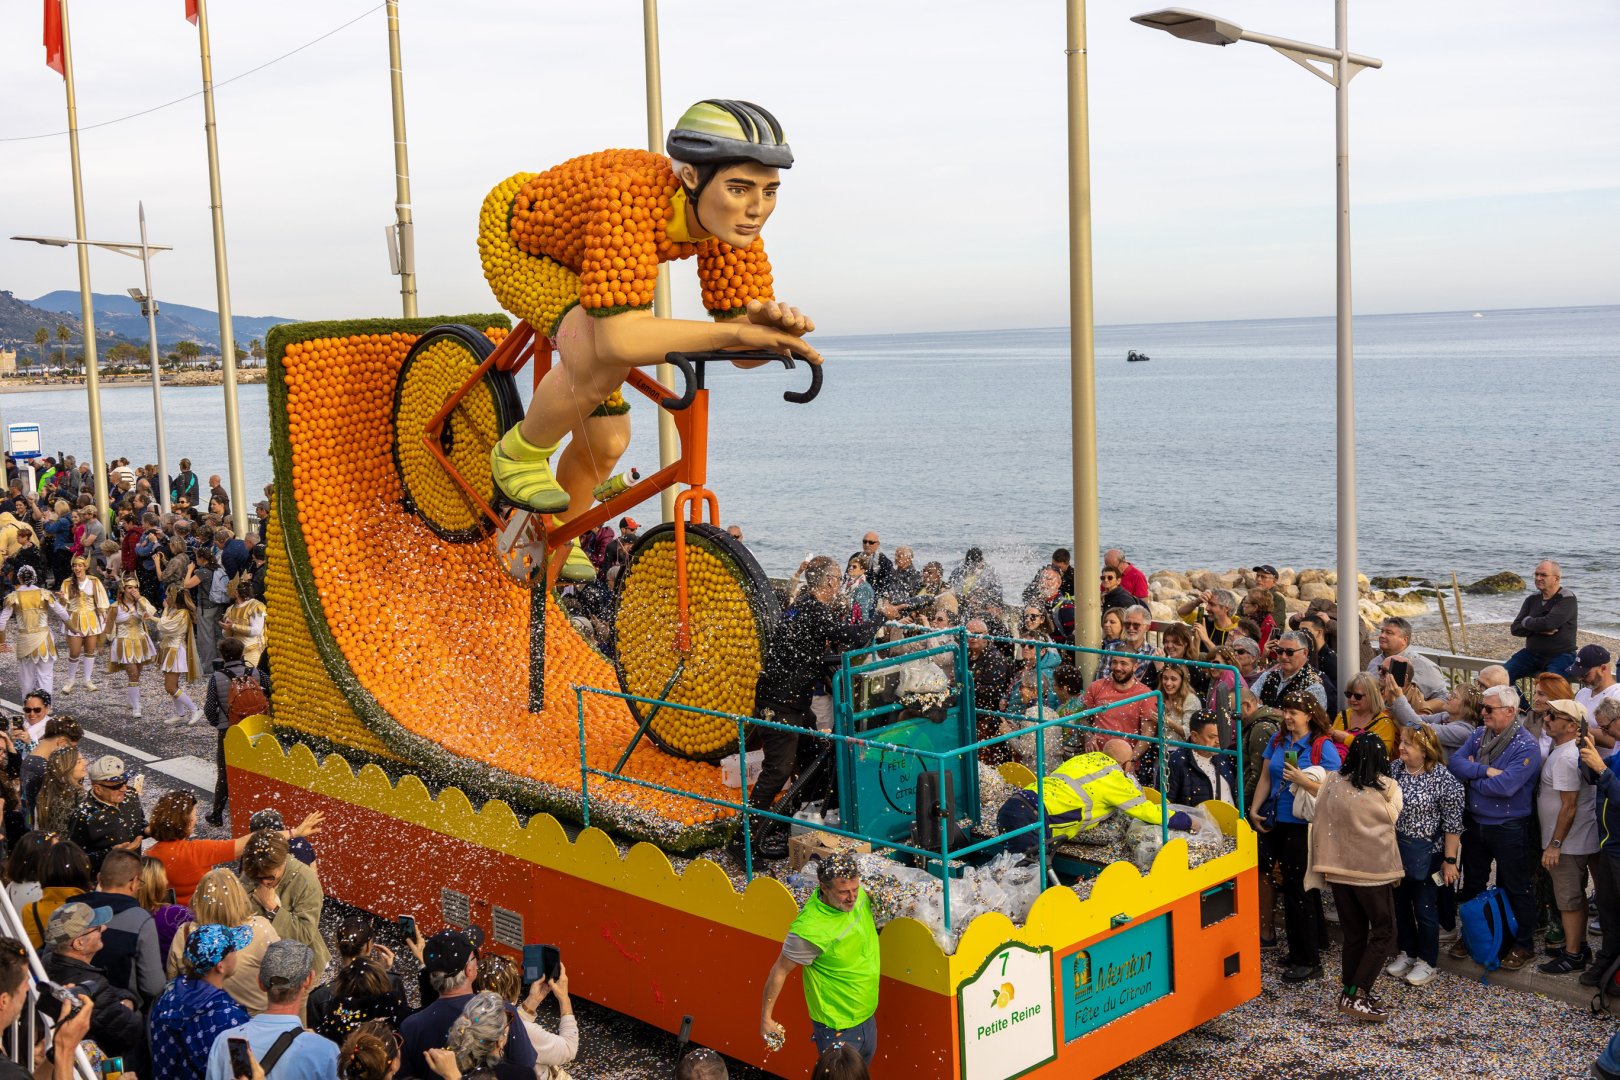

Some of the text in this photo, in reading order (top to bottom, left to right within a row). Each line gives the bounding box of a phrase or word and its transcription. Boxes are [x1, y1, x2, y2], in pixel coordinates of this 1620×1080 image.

[637, 379, 660, 399] Lemon
[998, 951, 1010, 977] 7
[1095, 951, 1152, 994] Menton
[977, 1003, 1042, 1041] Petite Reine
[1074, 981, 1152, 1029] Fête du Citron
